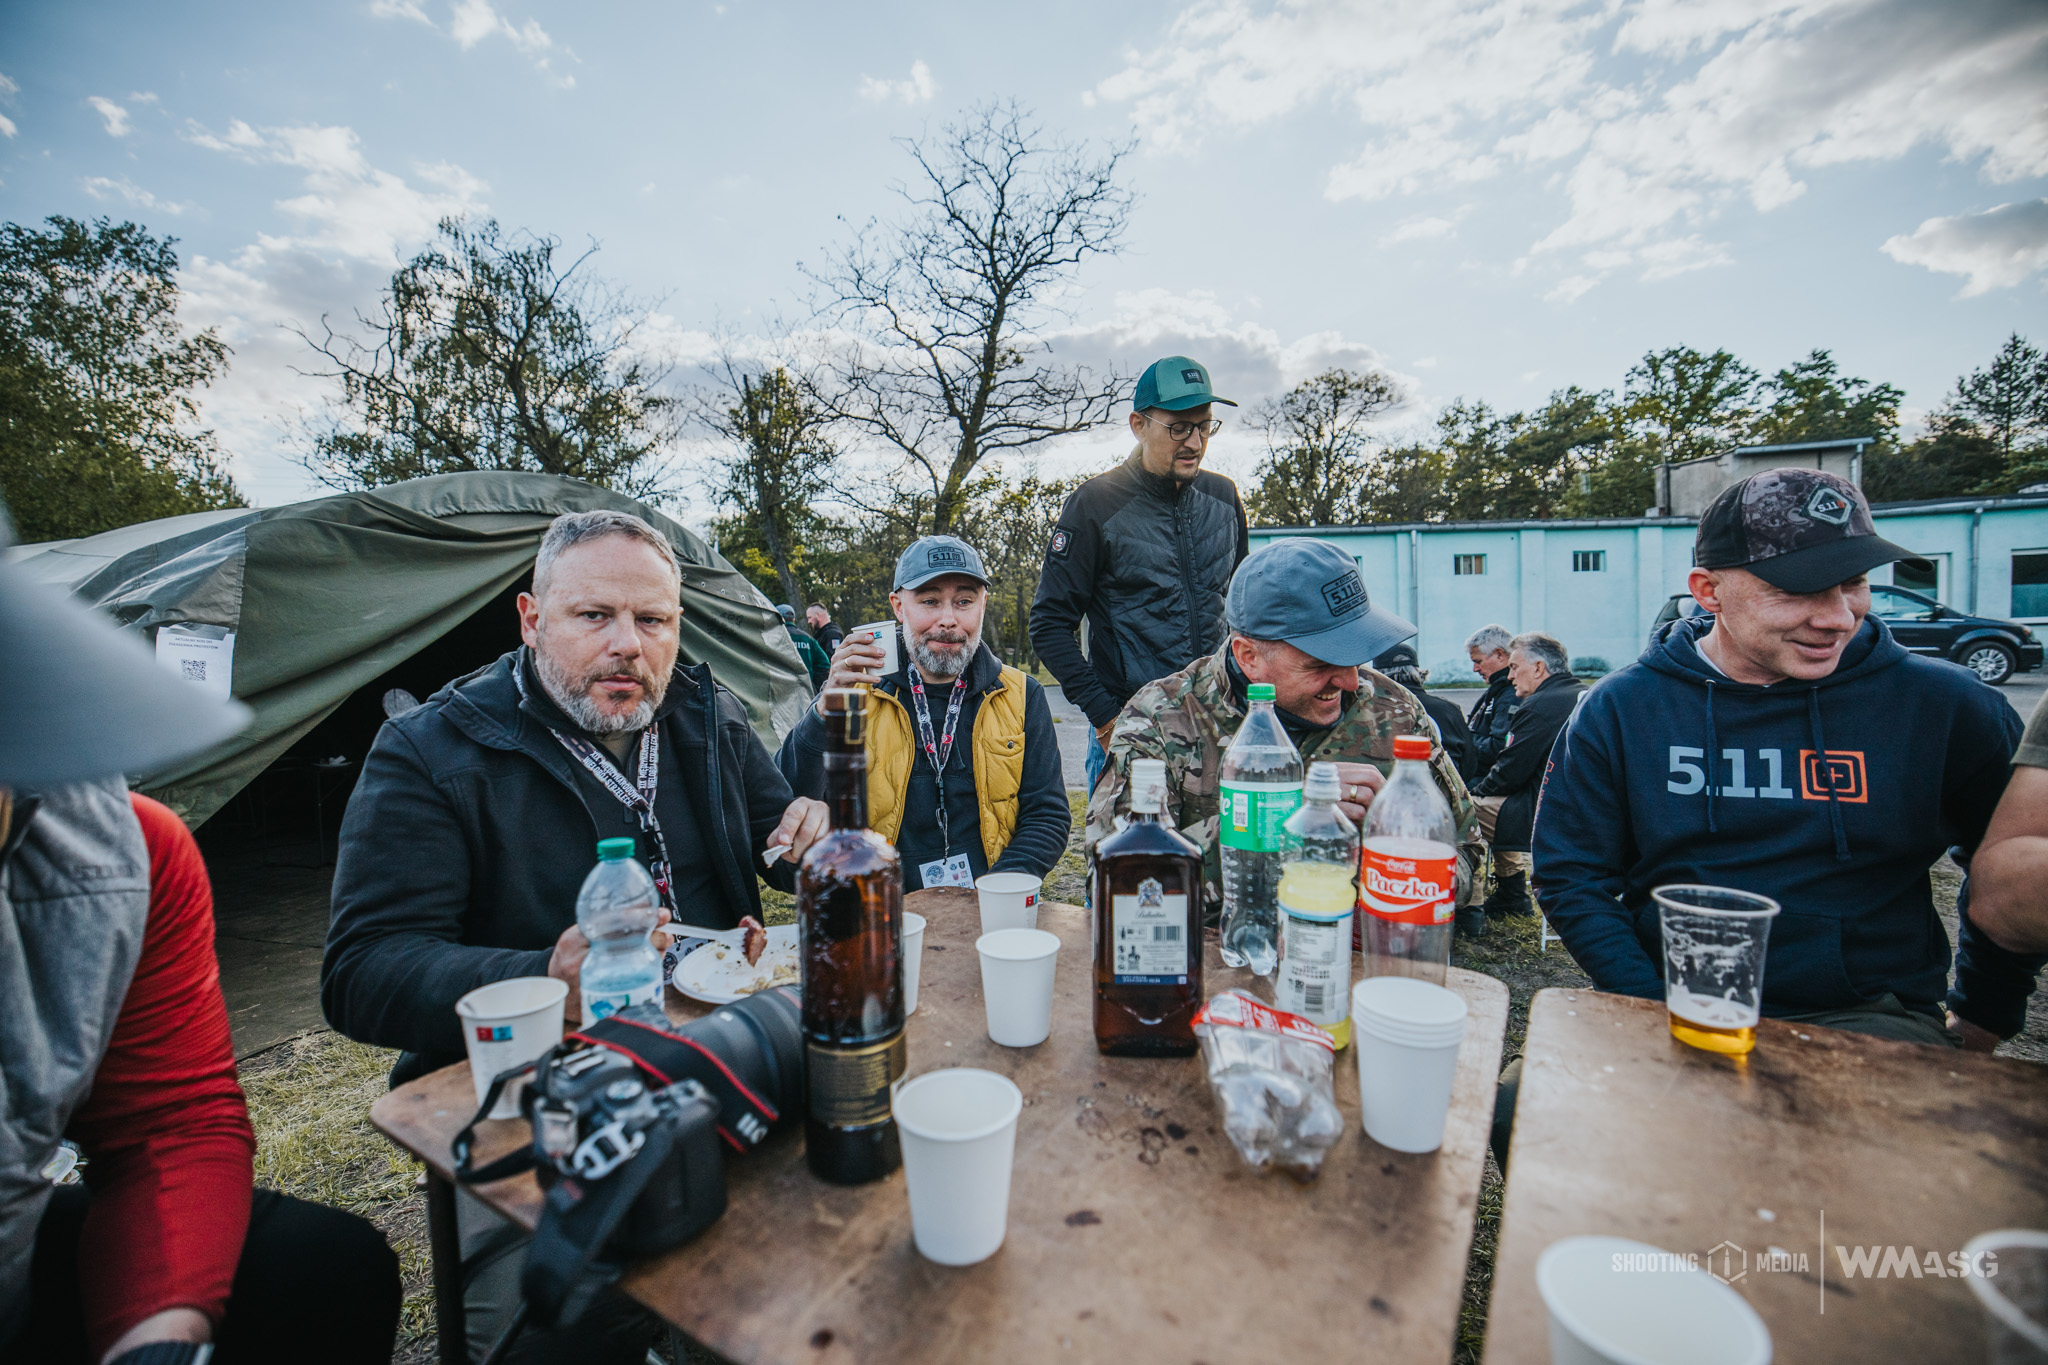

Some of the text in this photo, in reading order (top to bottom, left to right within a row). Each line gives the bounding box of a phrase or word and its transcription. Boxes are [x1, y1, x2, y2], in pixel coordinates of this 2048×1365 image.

[1817, 501, 1839, 513] 5.11
[933, 552, 953, 561] 5.11
[1331, 584, 1356, 605] 5.11
[1667, 746, 1794, 799] 5.11
[605, 778, 635, 808] STRZELECKI
[1368, 869, 1438, 897] Paczka
